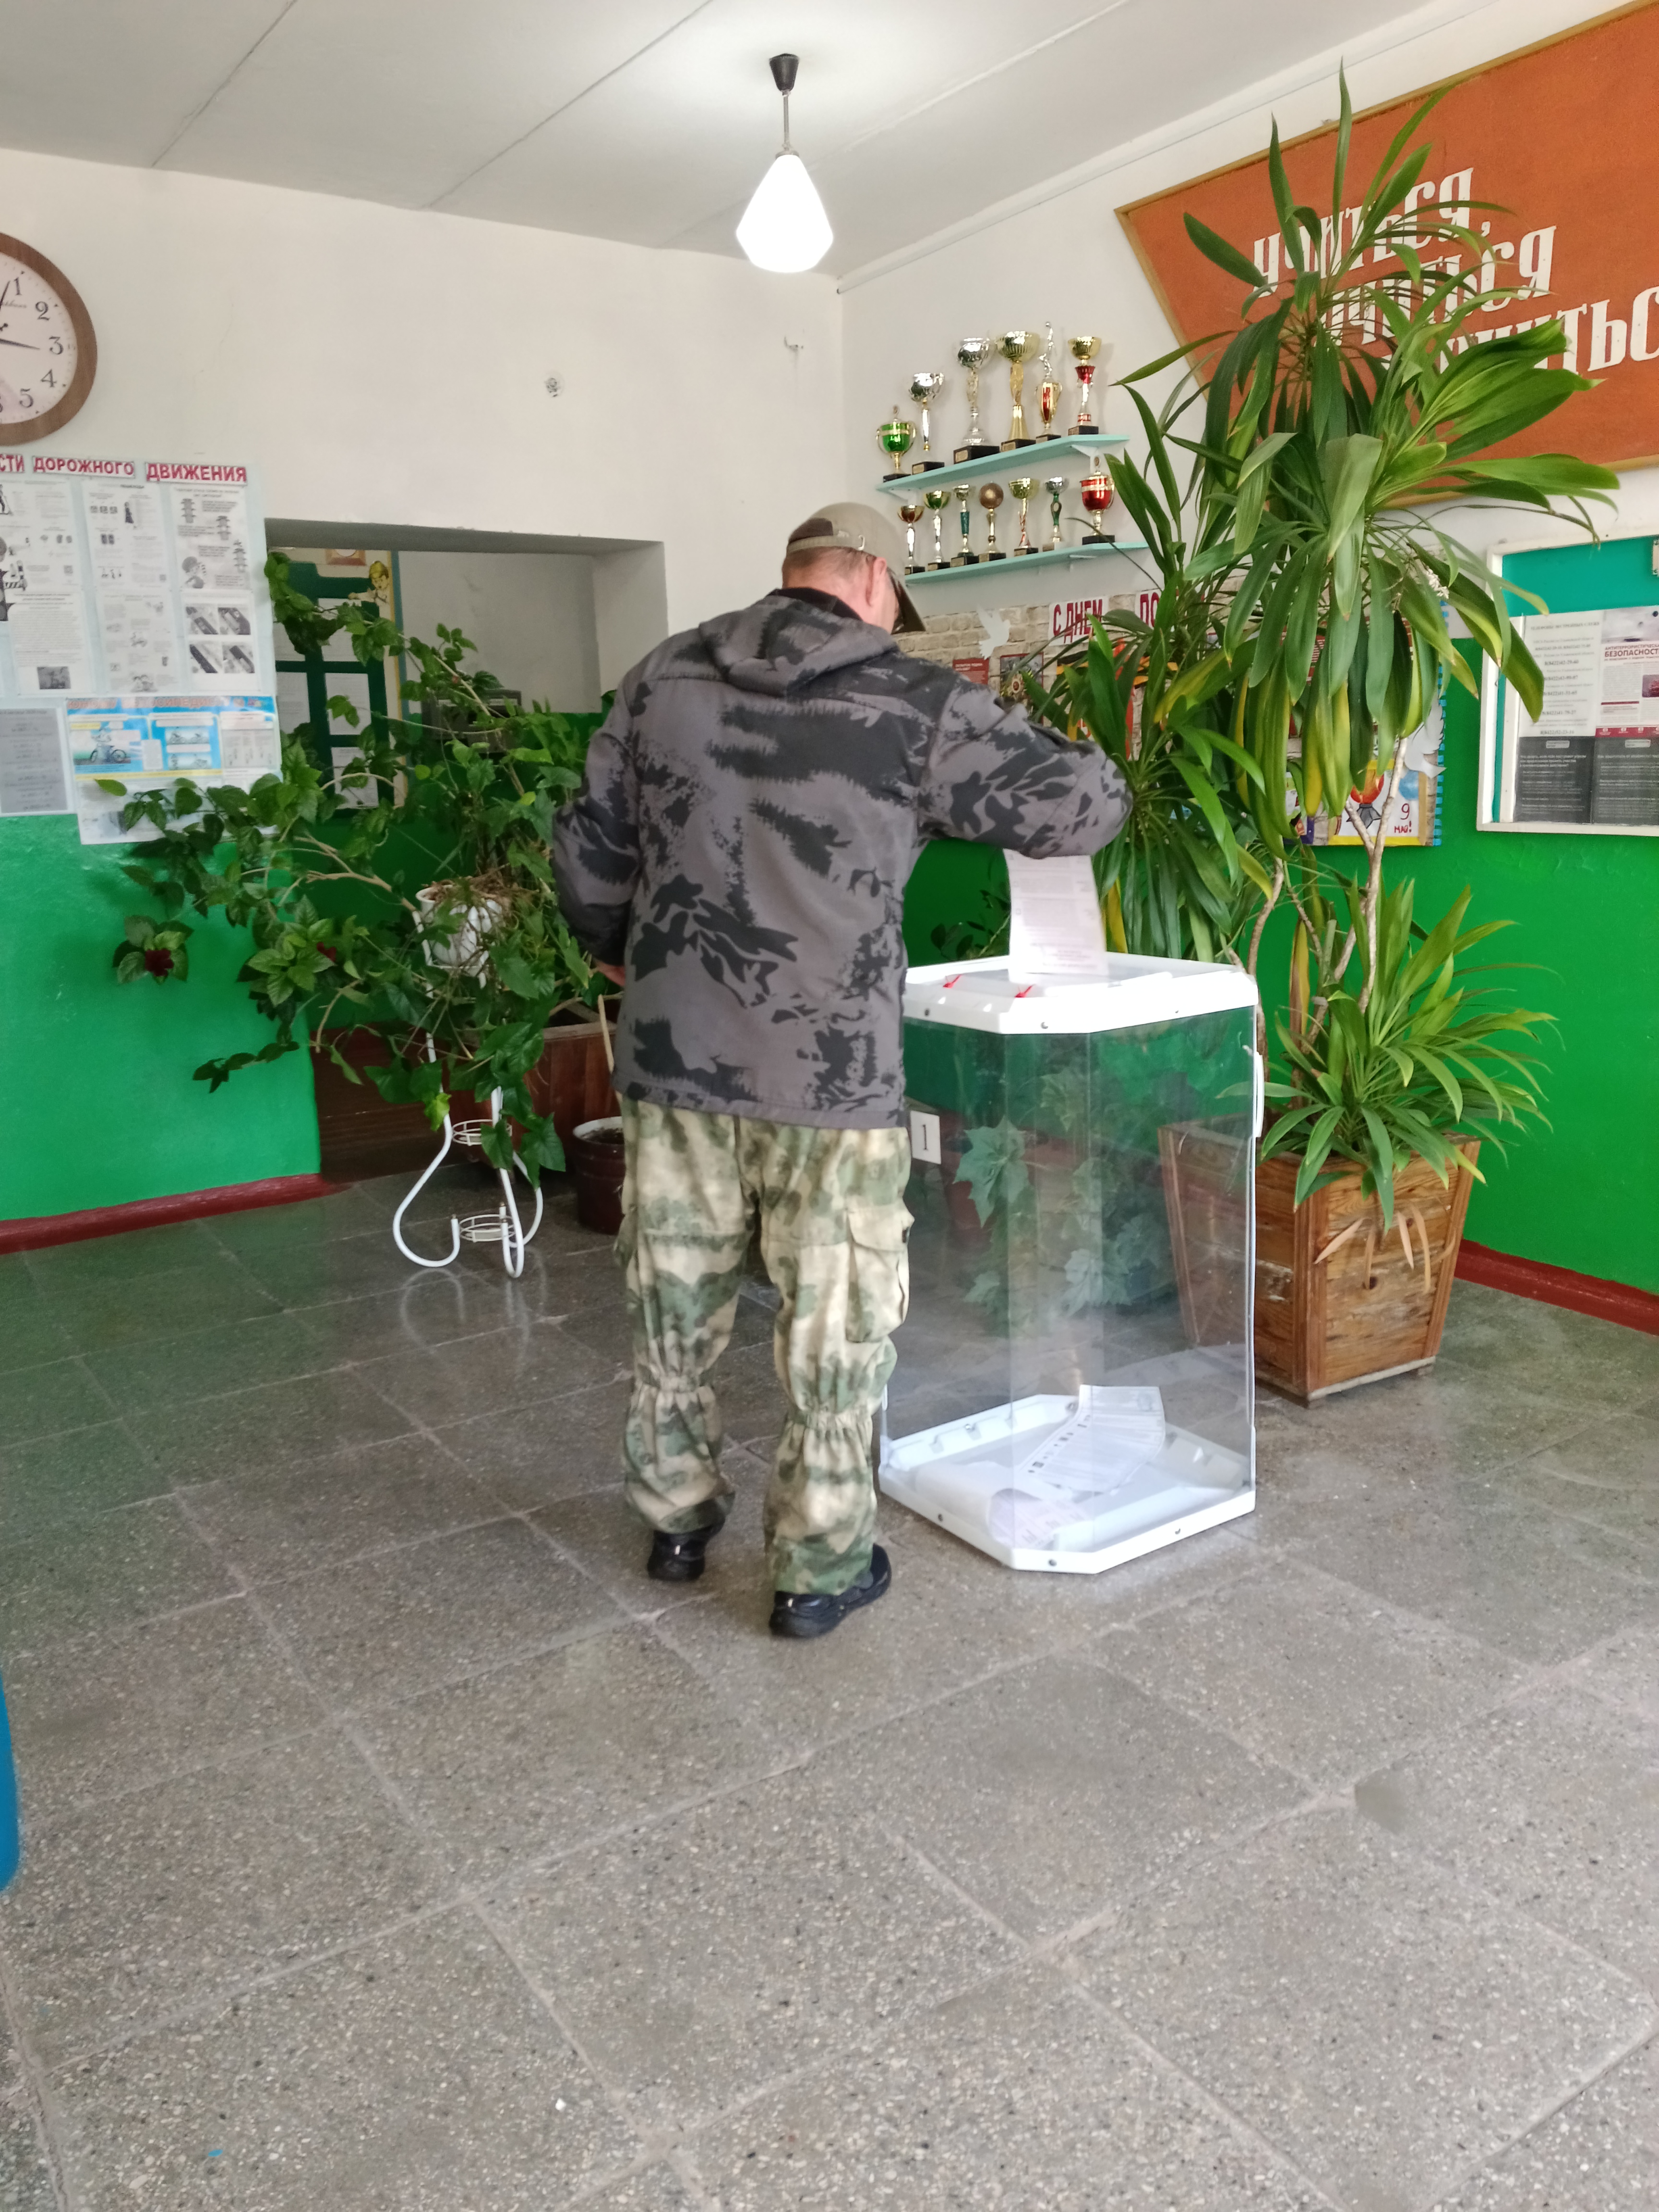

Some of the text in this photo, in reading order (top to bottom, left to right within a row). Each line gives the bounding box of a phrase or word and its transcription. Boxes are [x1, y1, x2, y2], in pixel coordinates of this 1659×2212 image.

[14, 277, 22, 296] 1
[36, 301, 50, 321] 2
[48, 337, 63, 355] 3
[41, 369, 57, 387] 4
[19, 388, 34, 408] 5
[34, 457, 134, 475] ДОРОЖНОГО
[146, 463, 246, 482] ДВИЖЕНИЯ
[1053, 604, 1061, 636] С
[1604, 649, 1659, 657] БЕЗОПАСНОСТ
[1400, 803, 1410, 820] 9
[922, 1124, 928, 1151] 1
